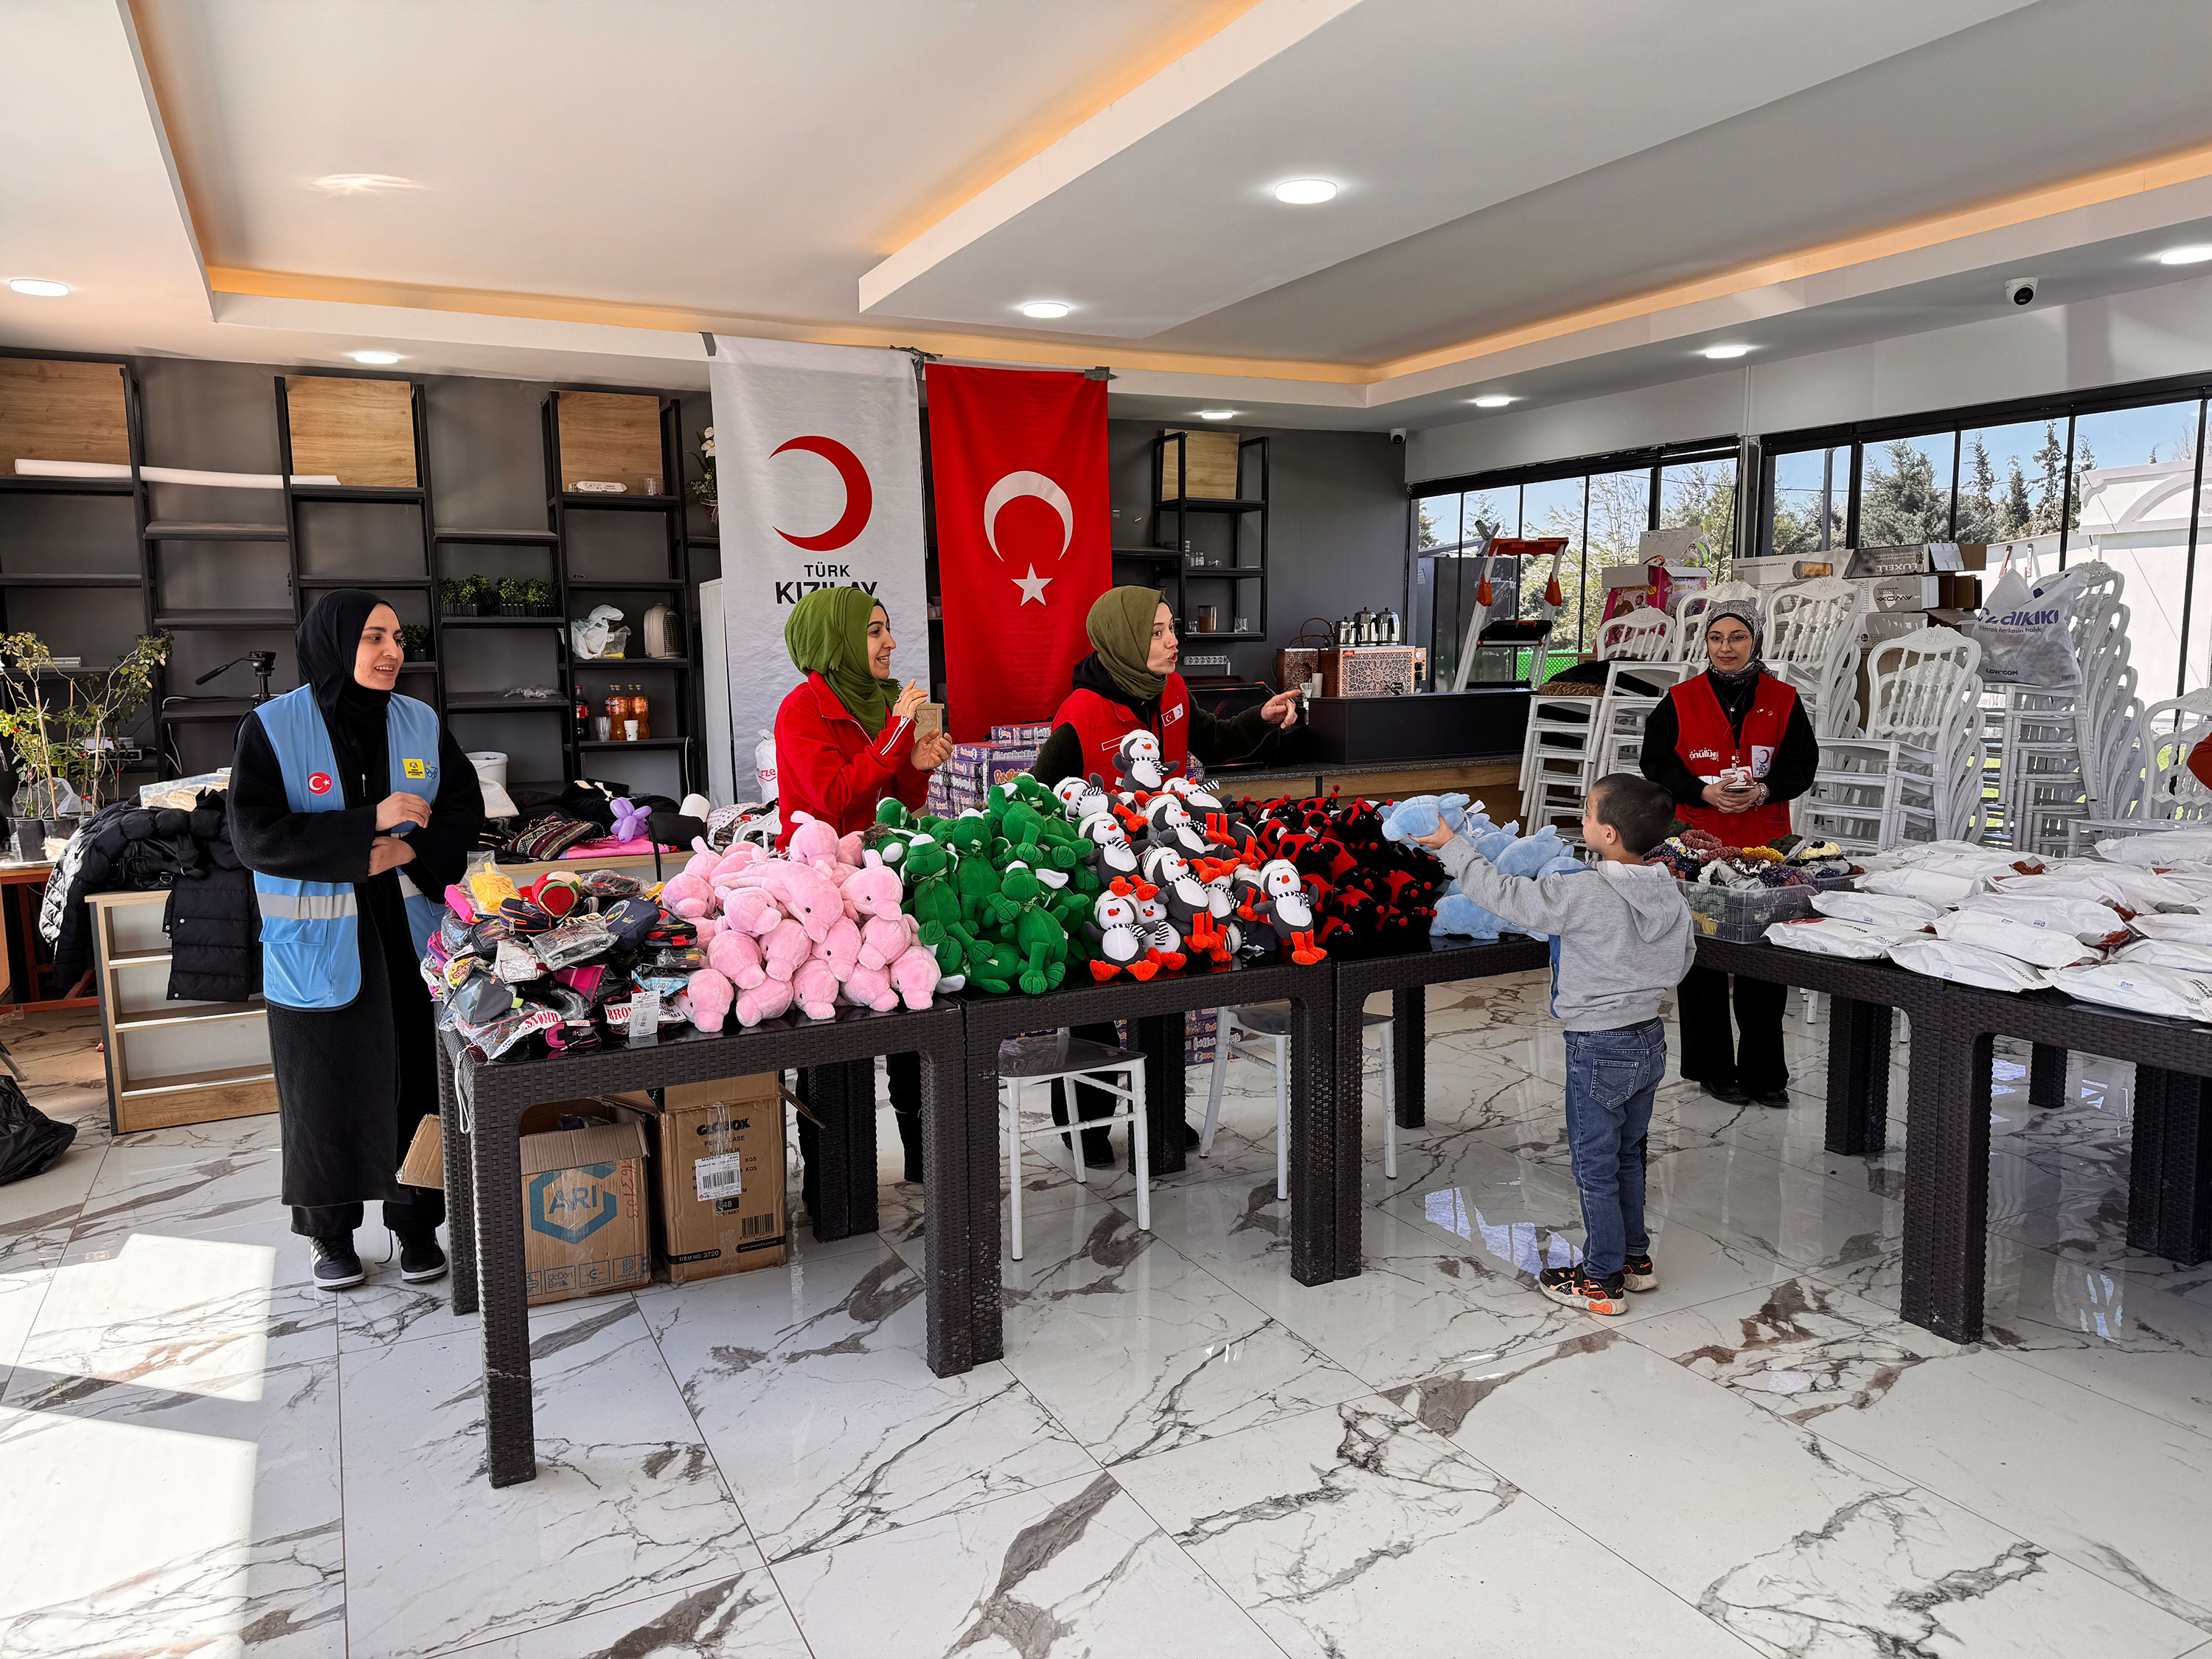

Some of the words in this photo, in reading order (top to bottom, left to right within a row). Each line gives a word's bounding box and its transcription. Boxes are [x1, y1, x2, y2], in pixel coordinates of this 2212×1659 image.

[804, 561, 850, 577] TÜRK
[548, 1185, 597, 1214] ARI
[703, 1250, 720, 1259] 3720
